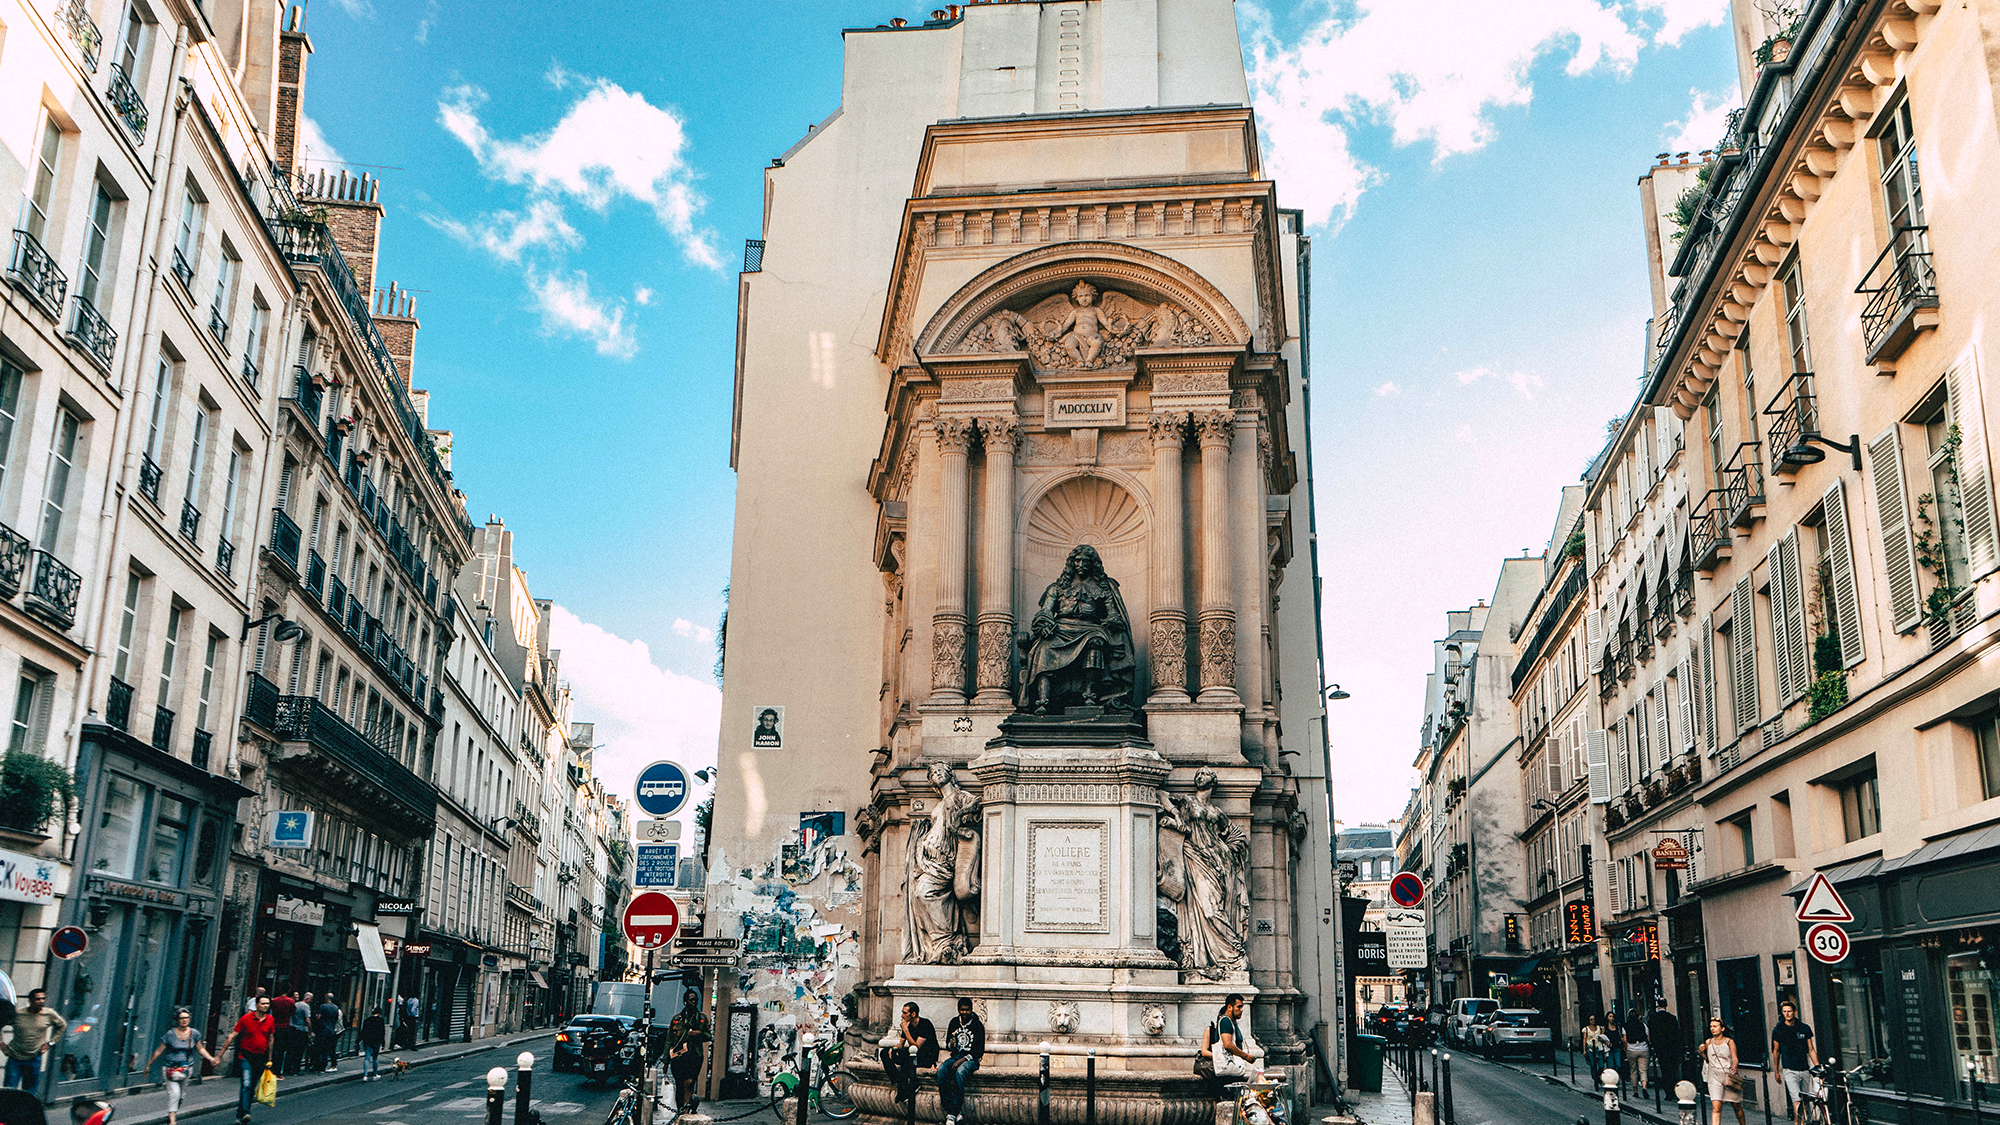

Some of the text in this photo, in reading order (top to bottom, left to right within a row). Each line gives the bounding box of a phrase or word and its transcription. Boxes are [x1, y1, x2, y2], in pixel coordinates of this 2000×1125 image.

[1058, 402, 1113, 414] MDCCCXLIV
[1044, 847, 1091, 857] MOLIERE
[15, 872, 53, 898] Voyages
[1569, 905, 1580, 942] PIZZA
[1581, 905, 1594, 943] RESTO
[1648, 926, 1660, 960] PIZZA
[1816, 935, 1839, 950] 30
[1358, 948, 1386, 959] DORIS
